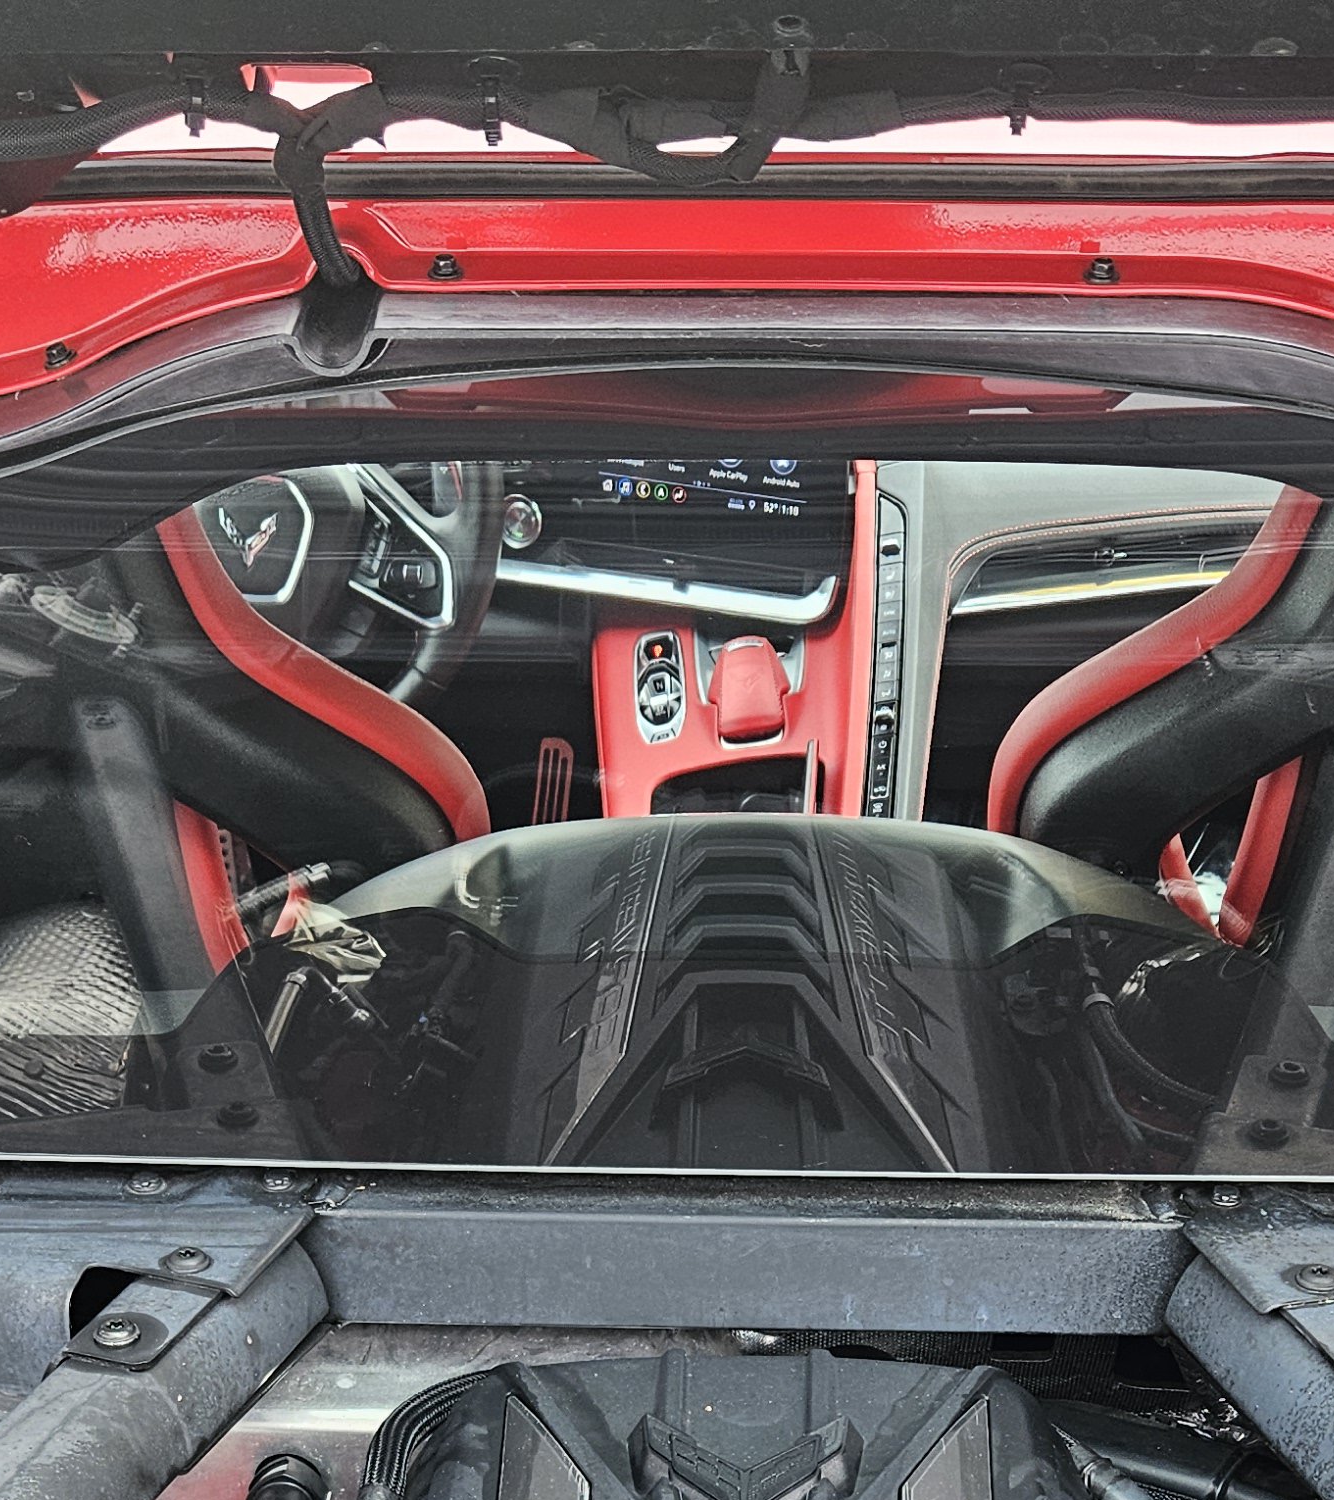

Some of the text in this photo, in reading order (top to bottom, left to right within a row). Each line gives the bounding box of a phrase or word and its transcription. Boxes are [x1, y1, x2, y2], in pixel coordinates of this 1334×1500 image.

[709, 468, 748, 483] Apple CarPlay
[763, 476, 800, 488] Android Auto
